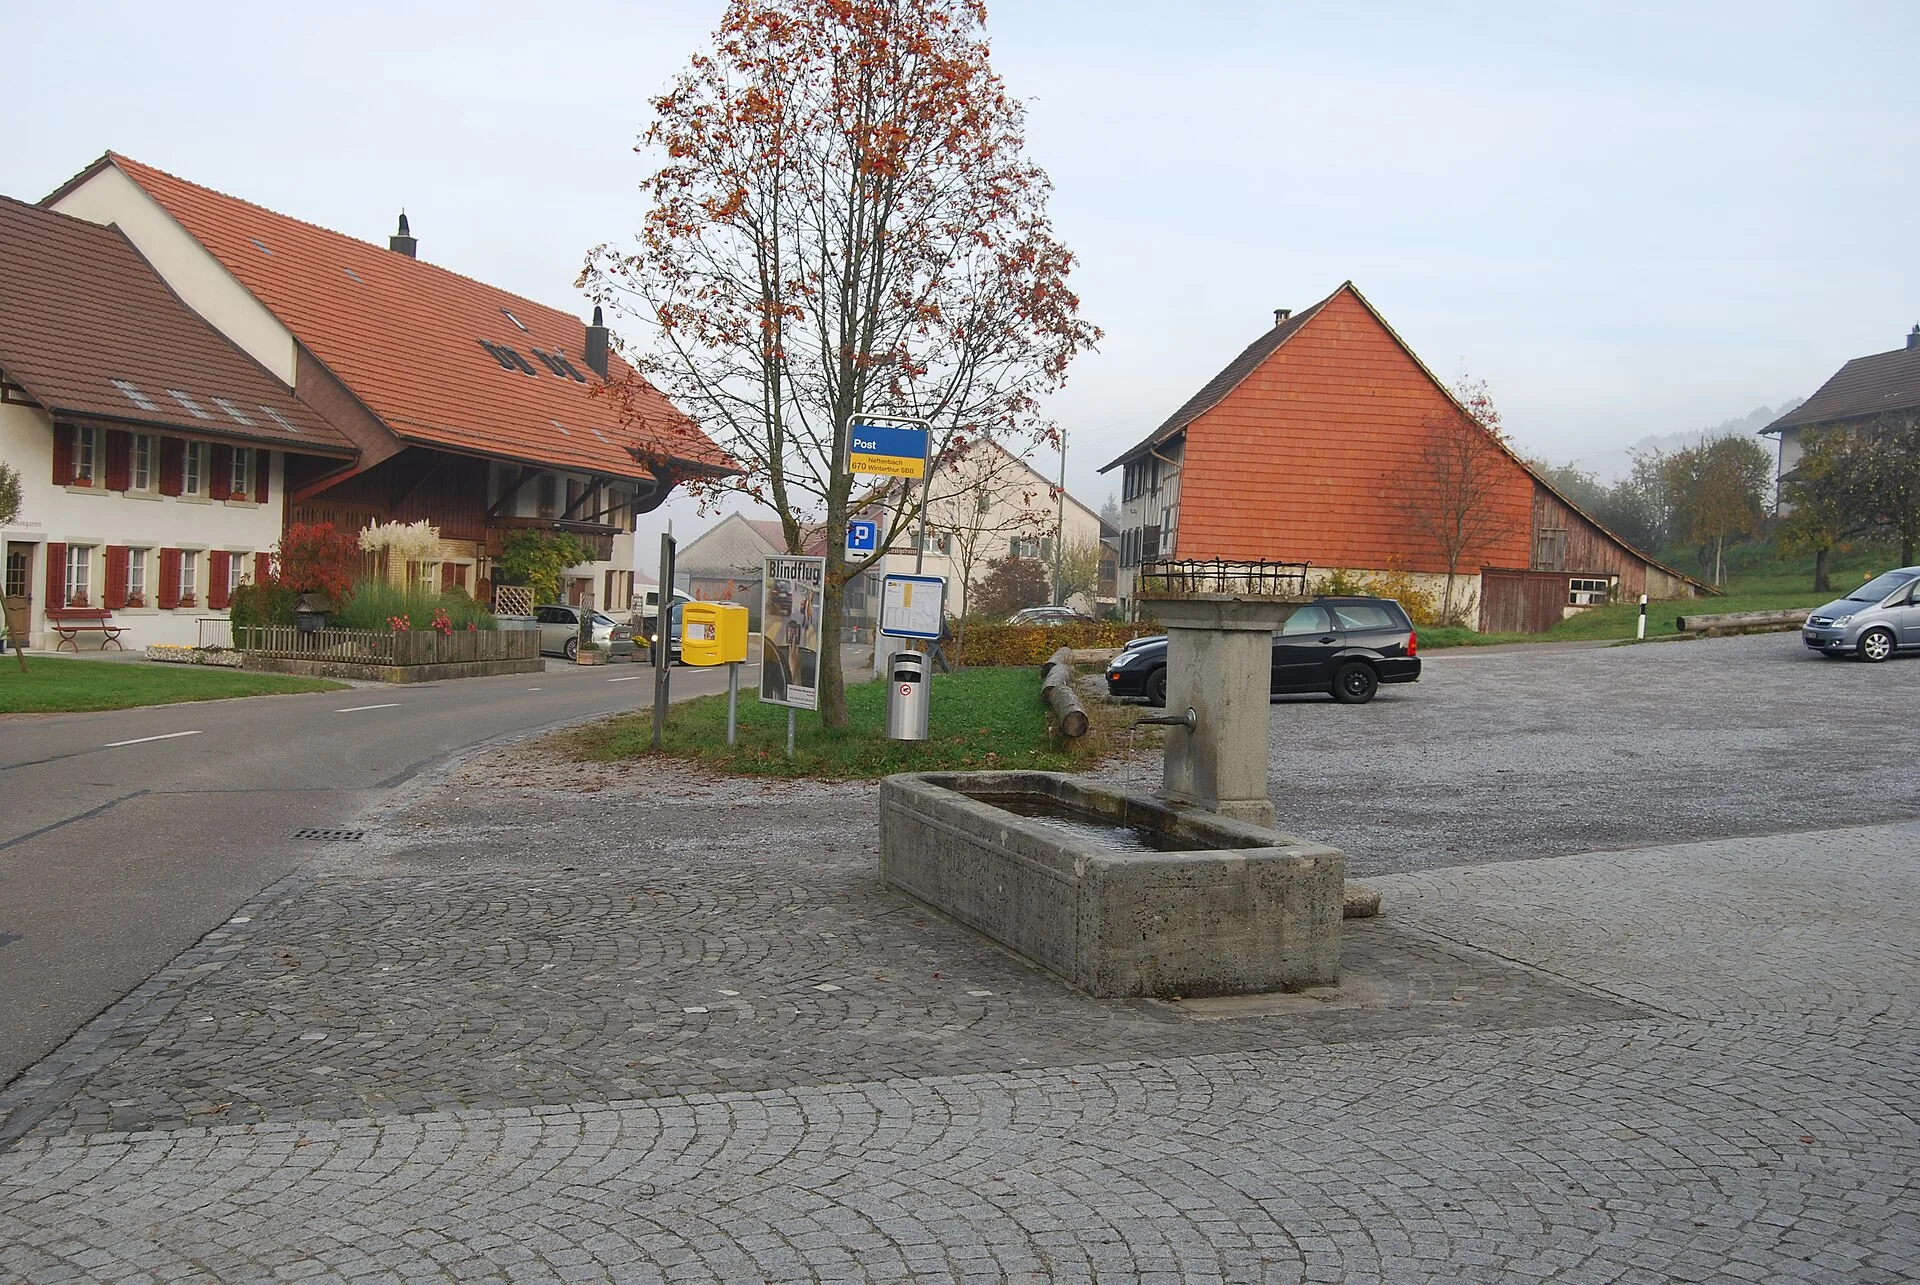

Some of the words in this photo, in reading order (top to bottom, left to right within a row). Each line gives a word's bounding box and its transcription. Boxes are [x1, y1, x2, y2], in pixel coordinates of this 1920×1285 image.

[853, 438, 877, 450] Post
[851, 461, 867, 470] 670
[868, 464, 900, 473] Winterthur
[868, 457, 903, 466] Neftenbach
[854, 525, 869, 546] P
[769, 560, 820, 585] Blindflug
